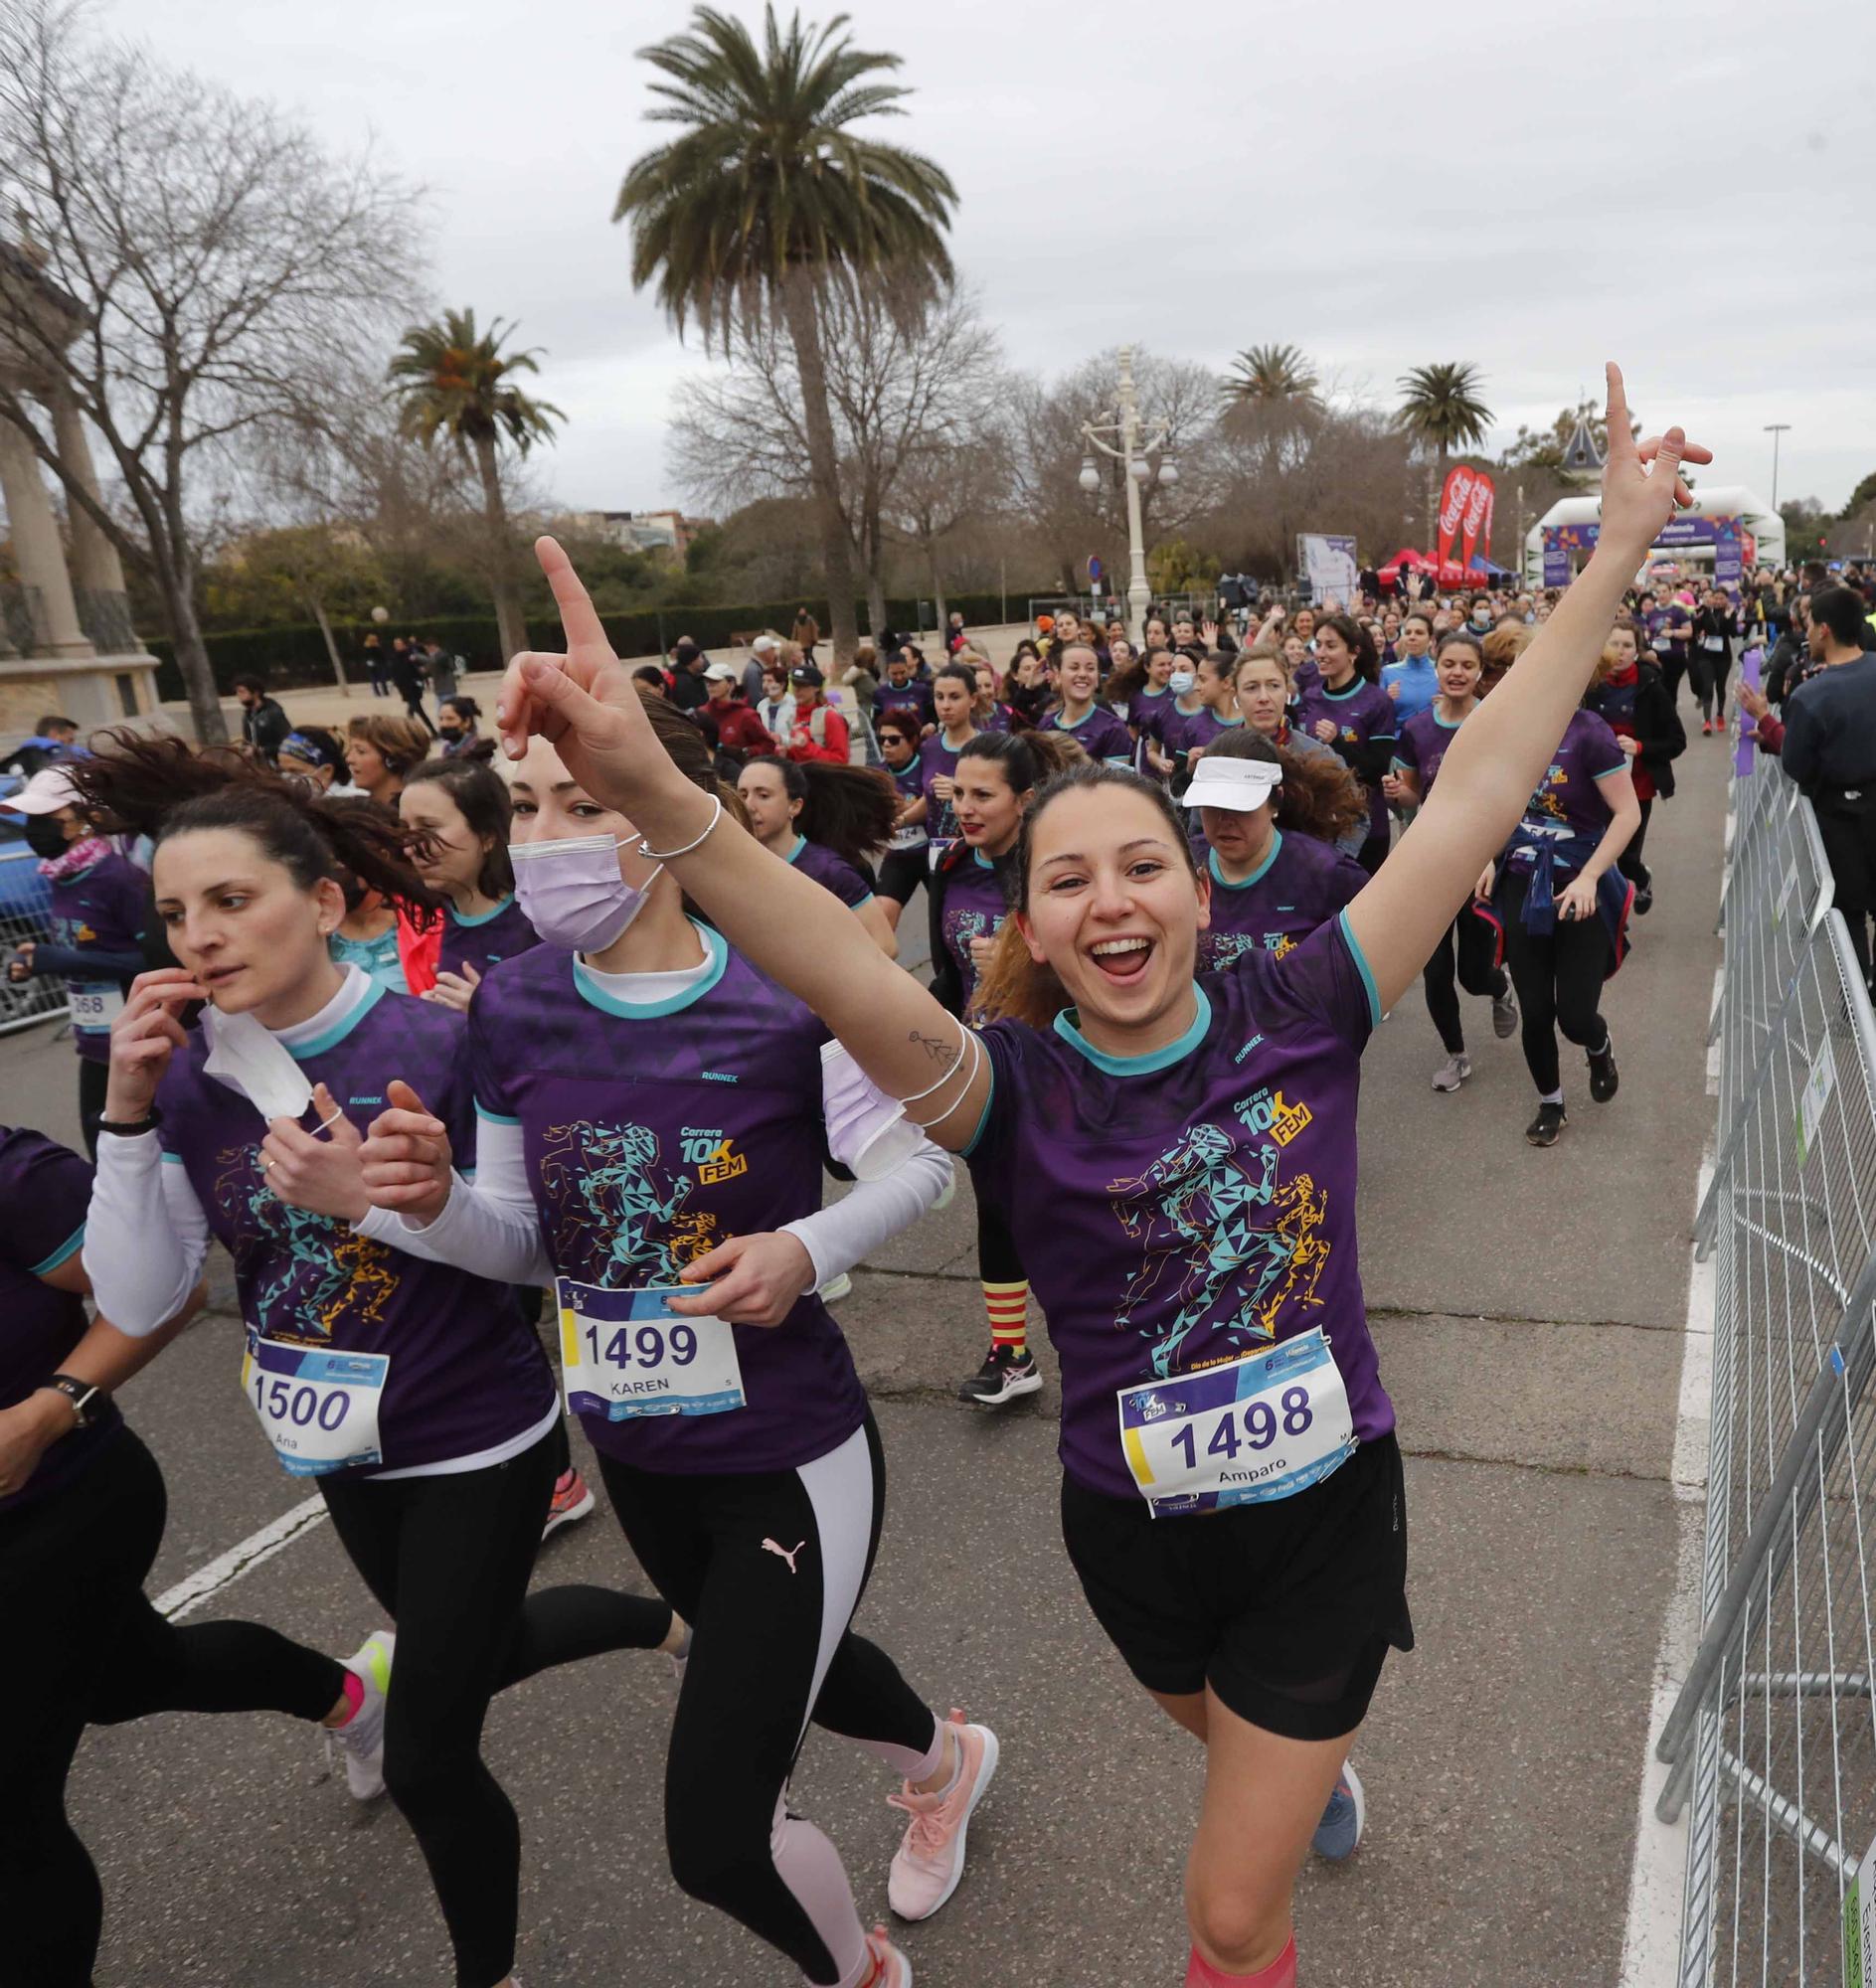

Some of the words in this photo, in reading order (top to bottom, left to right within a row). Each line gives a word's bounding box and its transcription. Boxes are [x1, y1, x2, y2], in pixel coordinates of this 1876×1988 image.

[1233, 1086, 1270, 1114] Carrera
[1239, 1090, 1293, 1136] 10K
[680, 1126, 723, 1137] Carrera
[1275, 1104, 1308, 1143] FEM
[679, 1138, 734, 1164] 10K
[703, 1157, 743, 1182] FEM
[585, 1324, 698, 1370] 1499
[610, 1378, 670, 1396] KAREN
[254, 1375, 351, 1431] 1500
[274, 1432, 298, 1450] Ana
[1170, 1386, 1313, 1470] 1498
[1219, 1458, 1286, 1483] Amparo
